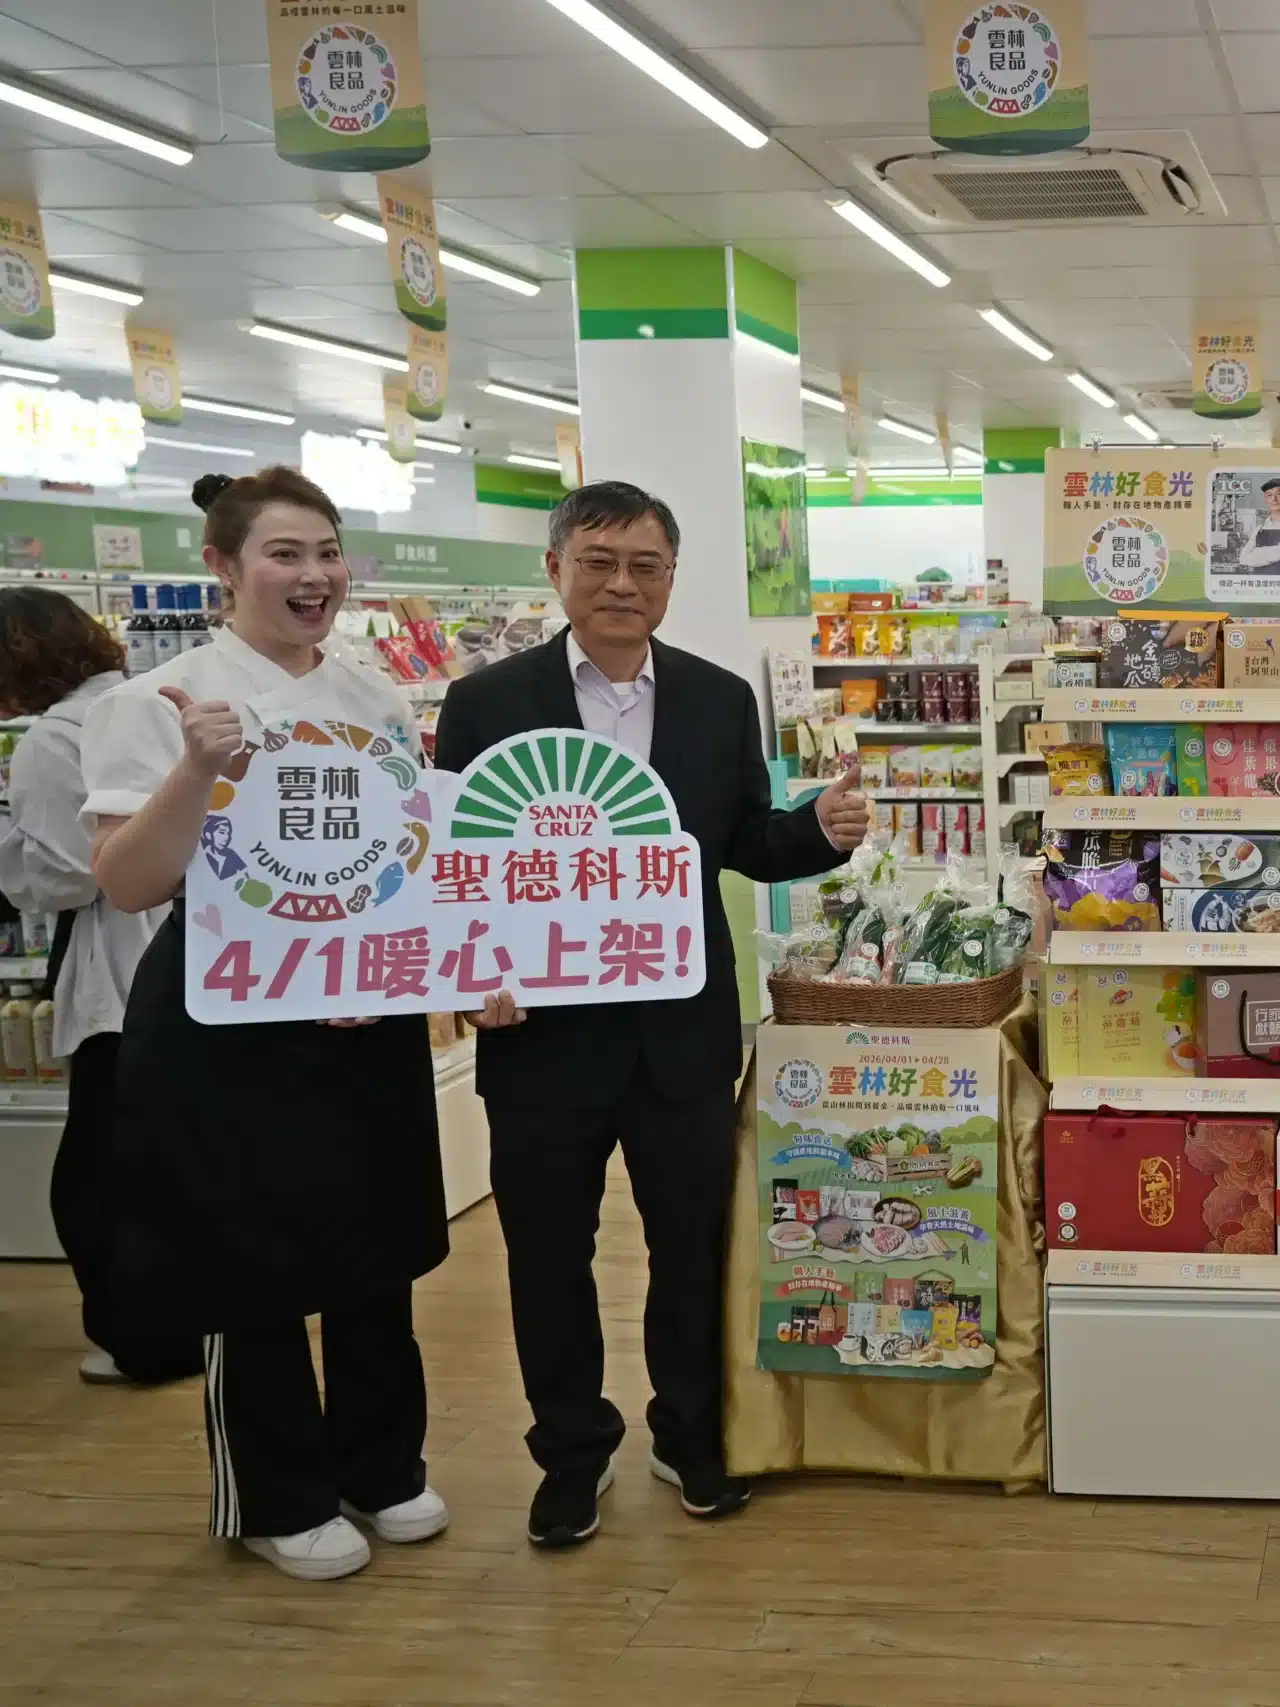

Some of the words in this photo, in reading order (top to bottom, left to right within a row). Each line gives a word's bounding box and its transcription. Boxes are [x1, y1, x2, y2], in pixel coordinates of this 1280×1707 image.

[988, 29, 1025, 49] 雲林
[327, 50, 363, 69] 雲林
[989, 51, 1026, 70] 良品
[329, 71, 364, 90] 良品
[977, 71, 1008, 95] YUNLIN
[1010, 68, 1039, 95] GOODS
[319, 90, 348, 114] YUNLIN
[350, 89, 377, 113] GOODS
[1063, 471, 1194, 497] 雲林好食光
[1112, 536, 1141, 551] 雲林
[1112, 553, 1141, 568] 良品
[277, 766, 360, 801] 雲林
[528, 804, 599, 821] SANTA
[278, 807, 361, 841] 良品
[533, 821, 594, 838] CRUZ
[248, 841, 317, 887] YUNLIN
[324, 836, 389, 888] GOODS
[431, 844, 692, 905] 聖德科斯
[871, 1035, 912, 1046] 聖德科斯
[859, 1054, 913, 1065] 2026/04/01
[922, 1055, 949, 1065] 04/28
[828, 1065, 978, 1098] 雲林好食光
